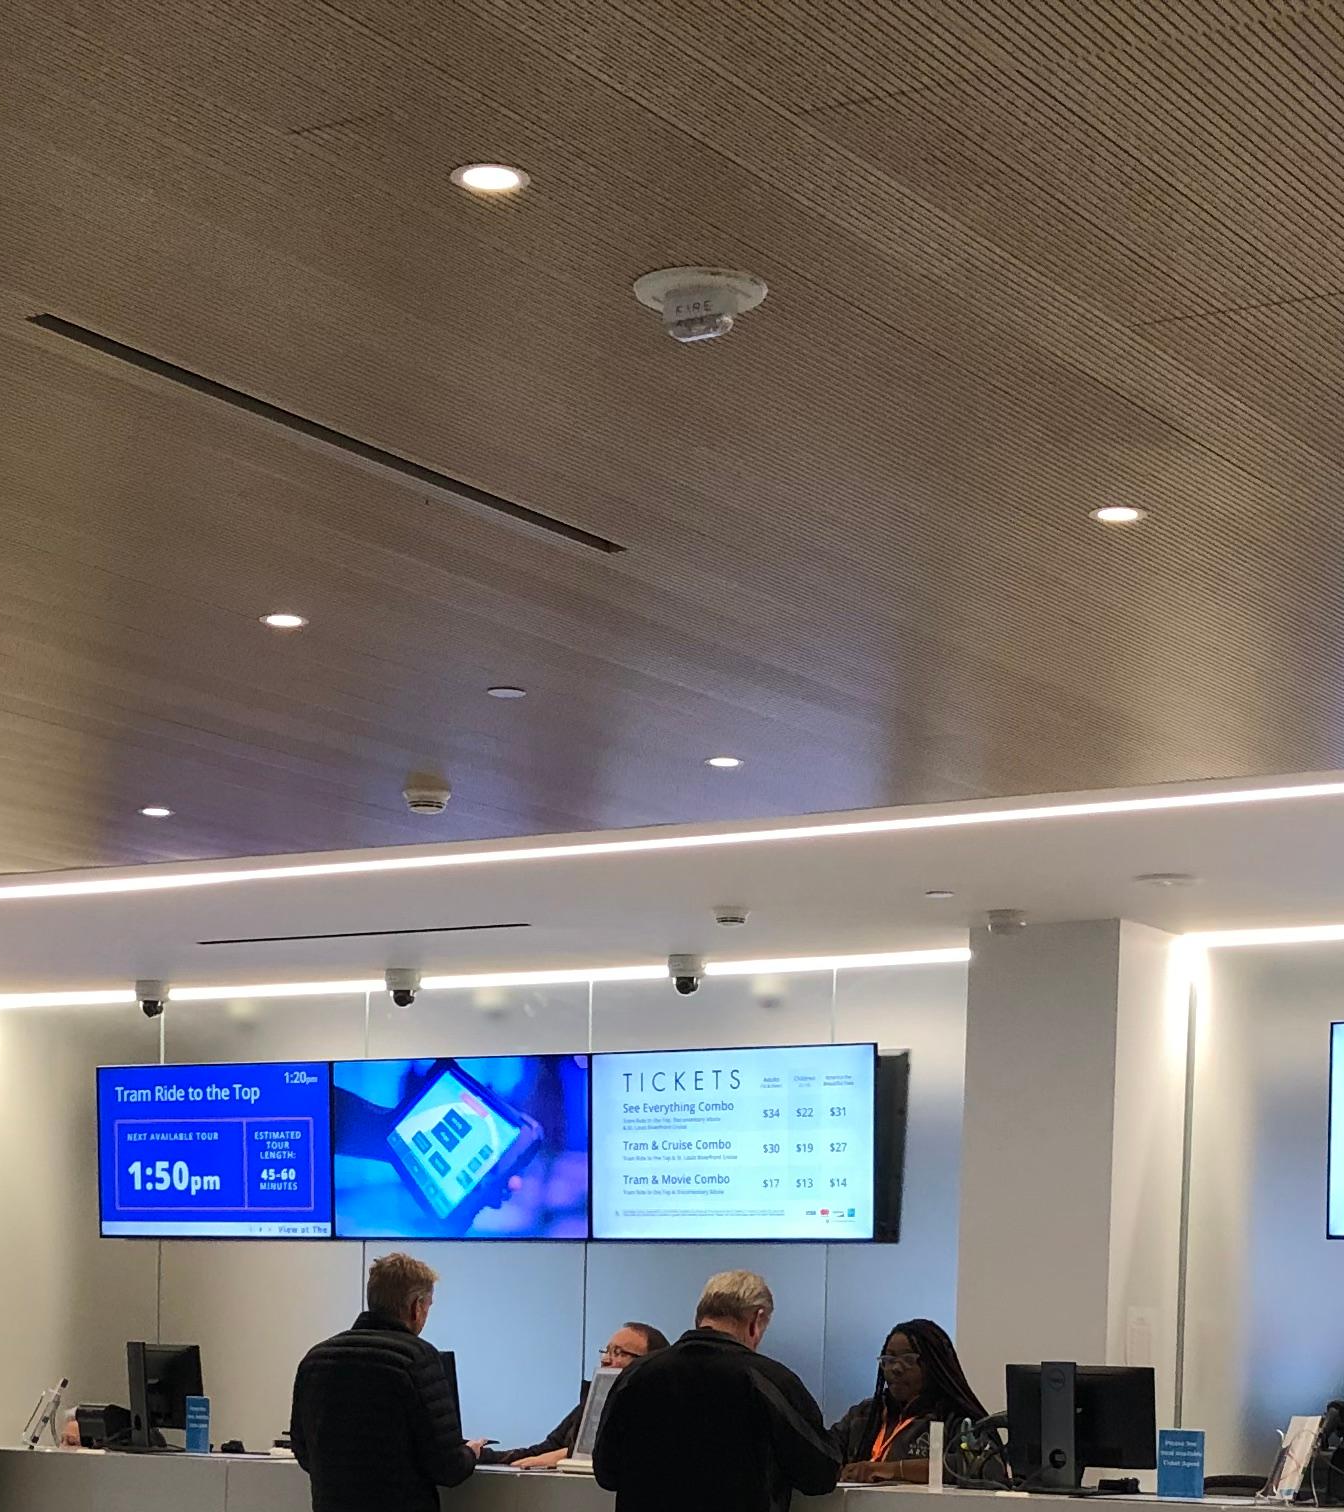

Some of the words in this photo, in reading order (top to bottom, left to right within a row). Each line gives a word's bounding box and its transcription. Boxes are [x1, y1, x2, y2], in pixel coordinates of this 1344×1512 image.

[675, 300, 714, 317] FIRE
[284, 1071, 318, 1085] 1:20pm
[622, 1069, 741, 1092] TICKETS
[115, 1086, 151, 1103] Tram
[156, 1085, 185, 1101] Ride
[188, 1087, 203, 1101] to
[206, 1085, 230, 1100] the
[232, 1084, 261, 1104] Top
[623, 1103, 640, 1113] See
[643, 1102, 696, 1115] Everything
[698, 1101, 734, 1112] Combo
[763, 1108, 780, 1118] $34
[796, 1107, 814, 1118] $22
[830, 1107, 846, 1117] $31
[127, 1133, 147, 1141] NEXT
[150, 1132, 193, 1141] AVAILABLE
[195, 1132, 219, 1140] TOUR
[255, 1131, 301, 1140] ESTIMATED
[266, 1141, 290, 1150] TOUR
[623, 1140, 648, 1151] Tram
[651, 1140, 658, 1150] &
[661, 1140, 692, 1150] Cruise
[695, 1139, 732, 1150] Combo
[763, 1143, 780, 1154] $30
[796, 1143, 814, 1153] $19
[830, 1142, 847, 1153] $27
[259, 1151, 296, 1160] LENGTH:
[127, 1161, 221, 1195] 1:50pm
[261, 1169, 296, 1181] 45-60
[623, 1175, 648, 1184] Tram
[651, 1175, 658, 1184] &
[661, 1174, 691, 1184] Movie
[694, 1174, 730, 1184] Combo
[259, 1182, 298, 1191] MINUTES
[763, 1179, 780, 1188] $17
[796, 1178, 813, 1188] $13
[830, 1178, 847, 1188] $14
